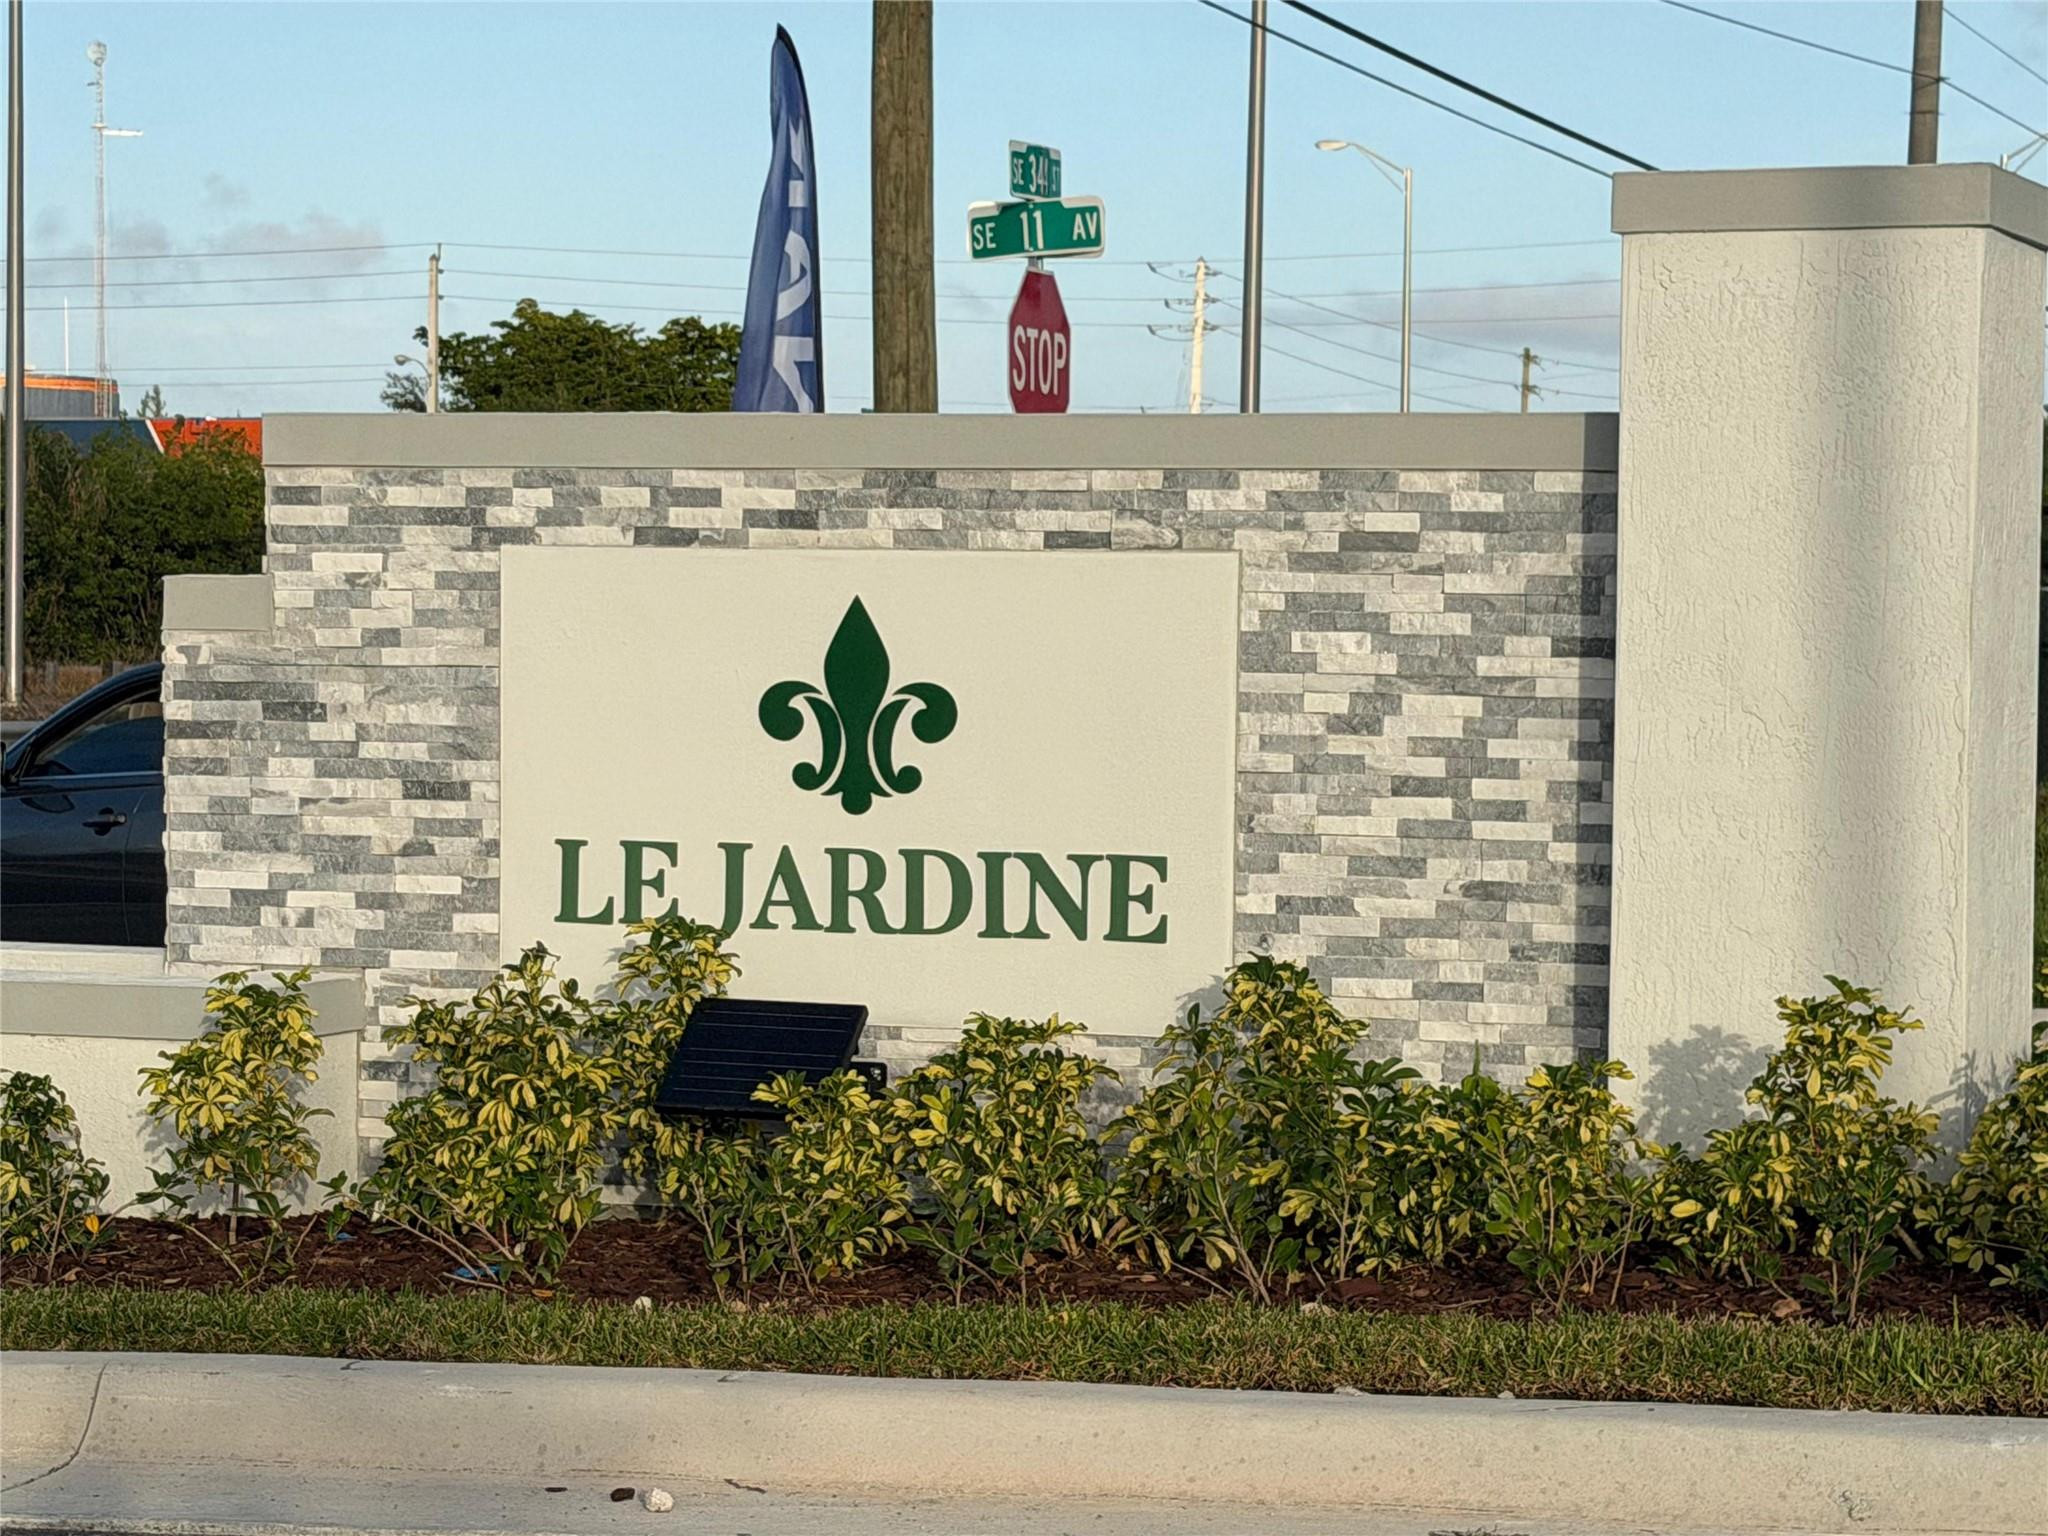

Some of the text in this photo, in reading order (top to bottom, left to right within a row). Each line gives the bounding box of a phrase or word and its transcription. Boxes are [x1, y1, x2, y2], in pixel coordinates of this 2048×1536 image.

[1013, 157, 1024, 185] SE
[973, 210, 1097, 250] SE 11 AV
[1012, 325, 1067, 396] STOP
[554, 838, 1168, 944] LE JARDINE
